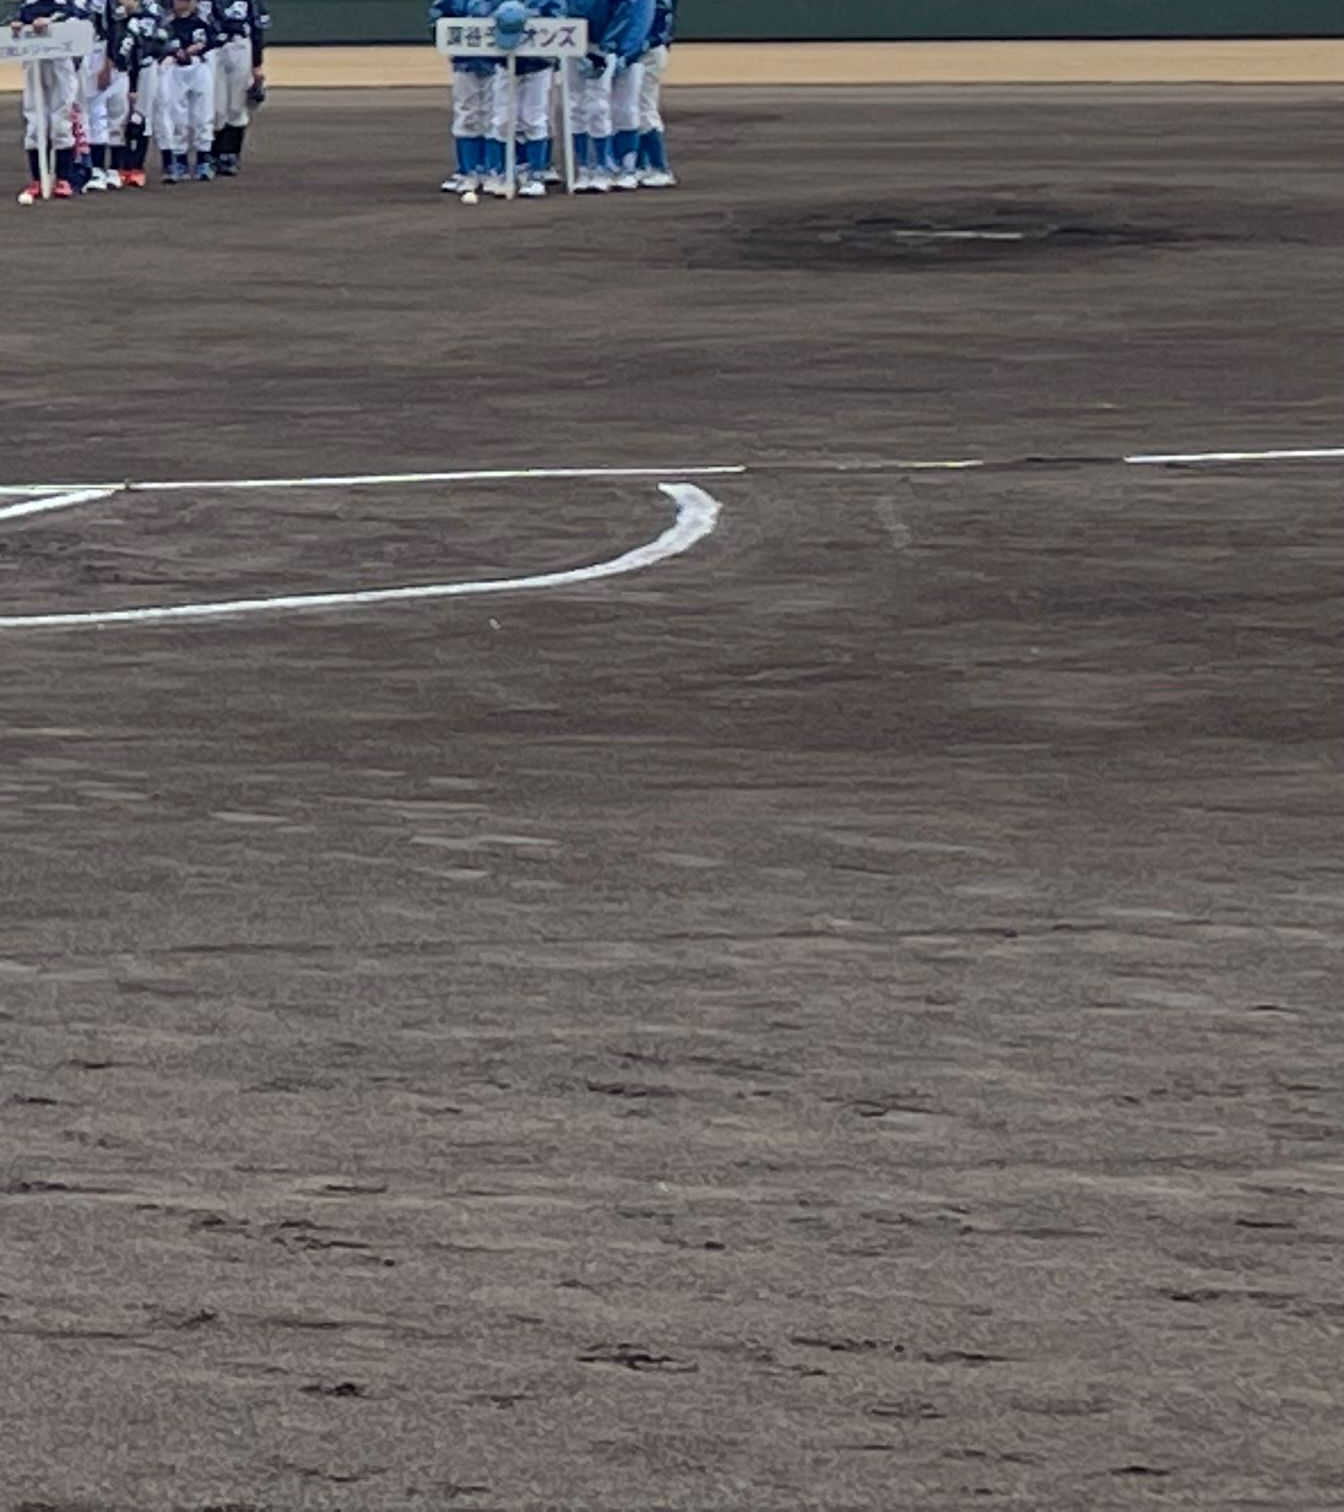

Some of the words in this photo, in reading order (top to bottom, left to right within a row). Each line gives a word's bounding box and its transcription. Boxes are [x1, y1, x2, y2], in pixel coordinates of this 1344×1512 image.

[446, 25, 578, 48] 深谷ラオンズ
